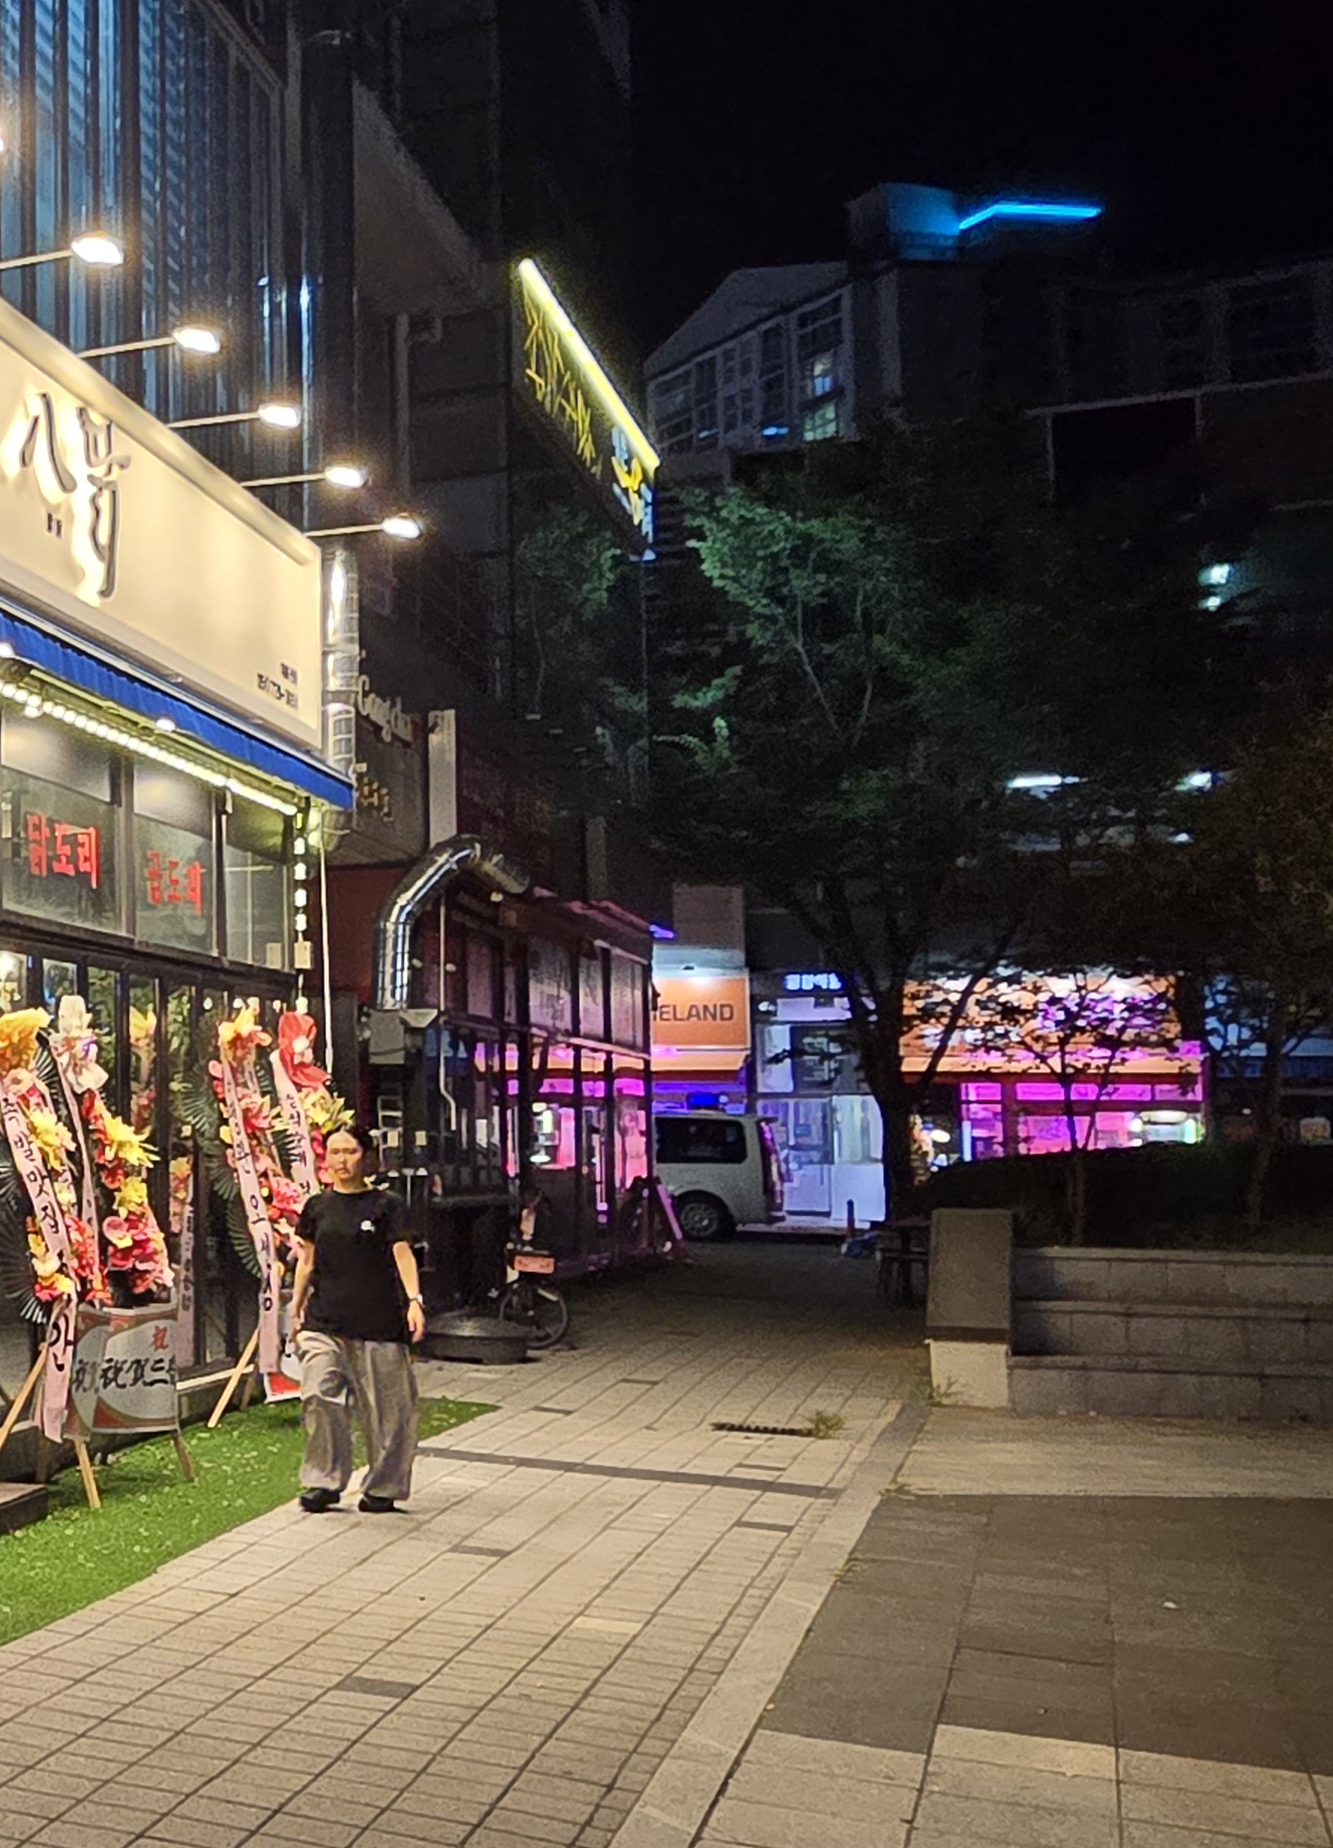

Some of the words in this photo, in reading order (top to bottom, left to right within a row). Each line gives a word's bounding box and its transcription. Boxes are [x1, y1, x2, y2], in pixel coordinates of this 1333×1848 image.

[26, 812, 100, 889] 닭도리
[653, 1004, 734, 1022] ELAND
[2, 1097, 62, 1235] 족발맛집
